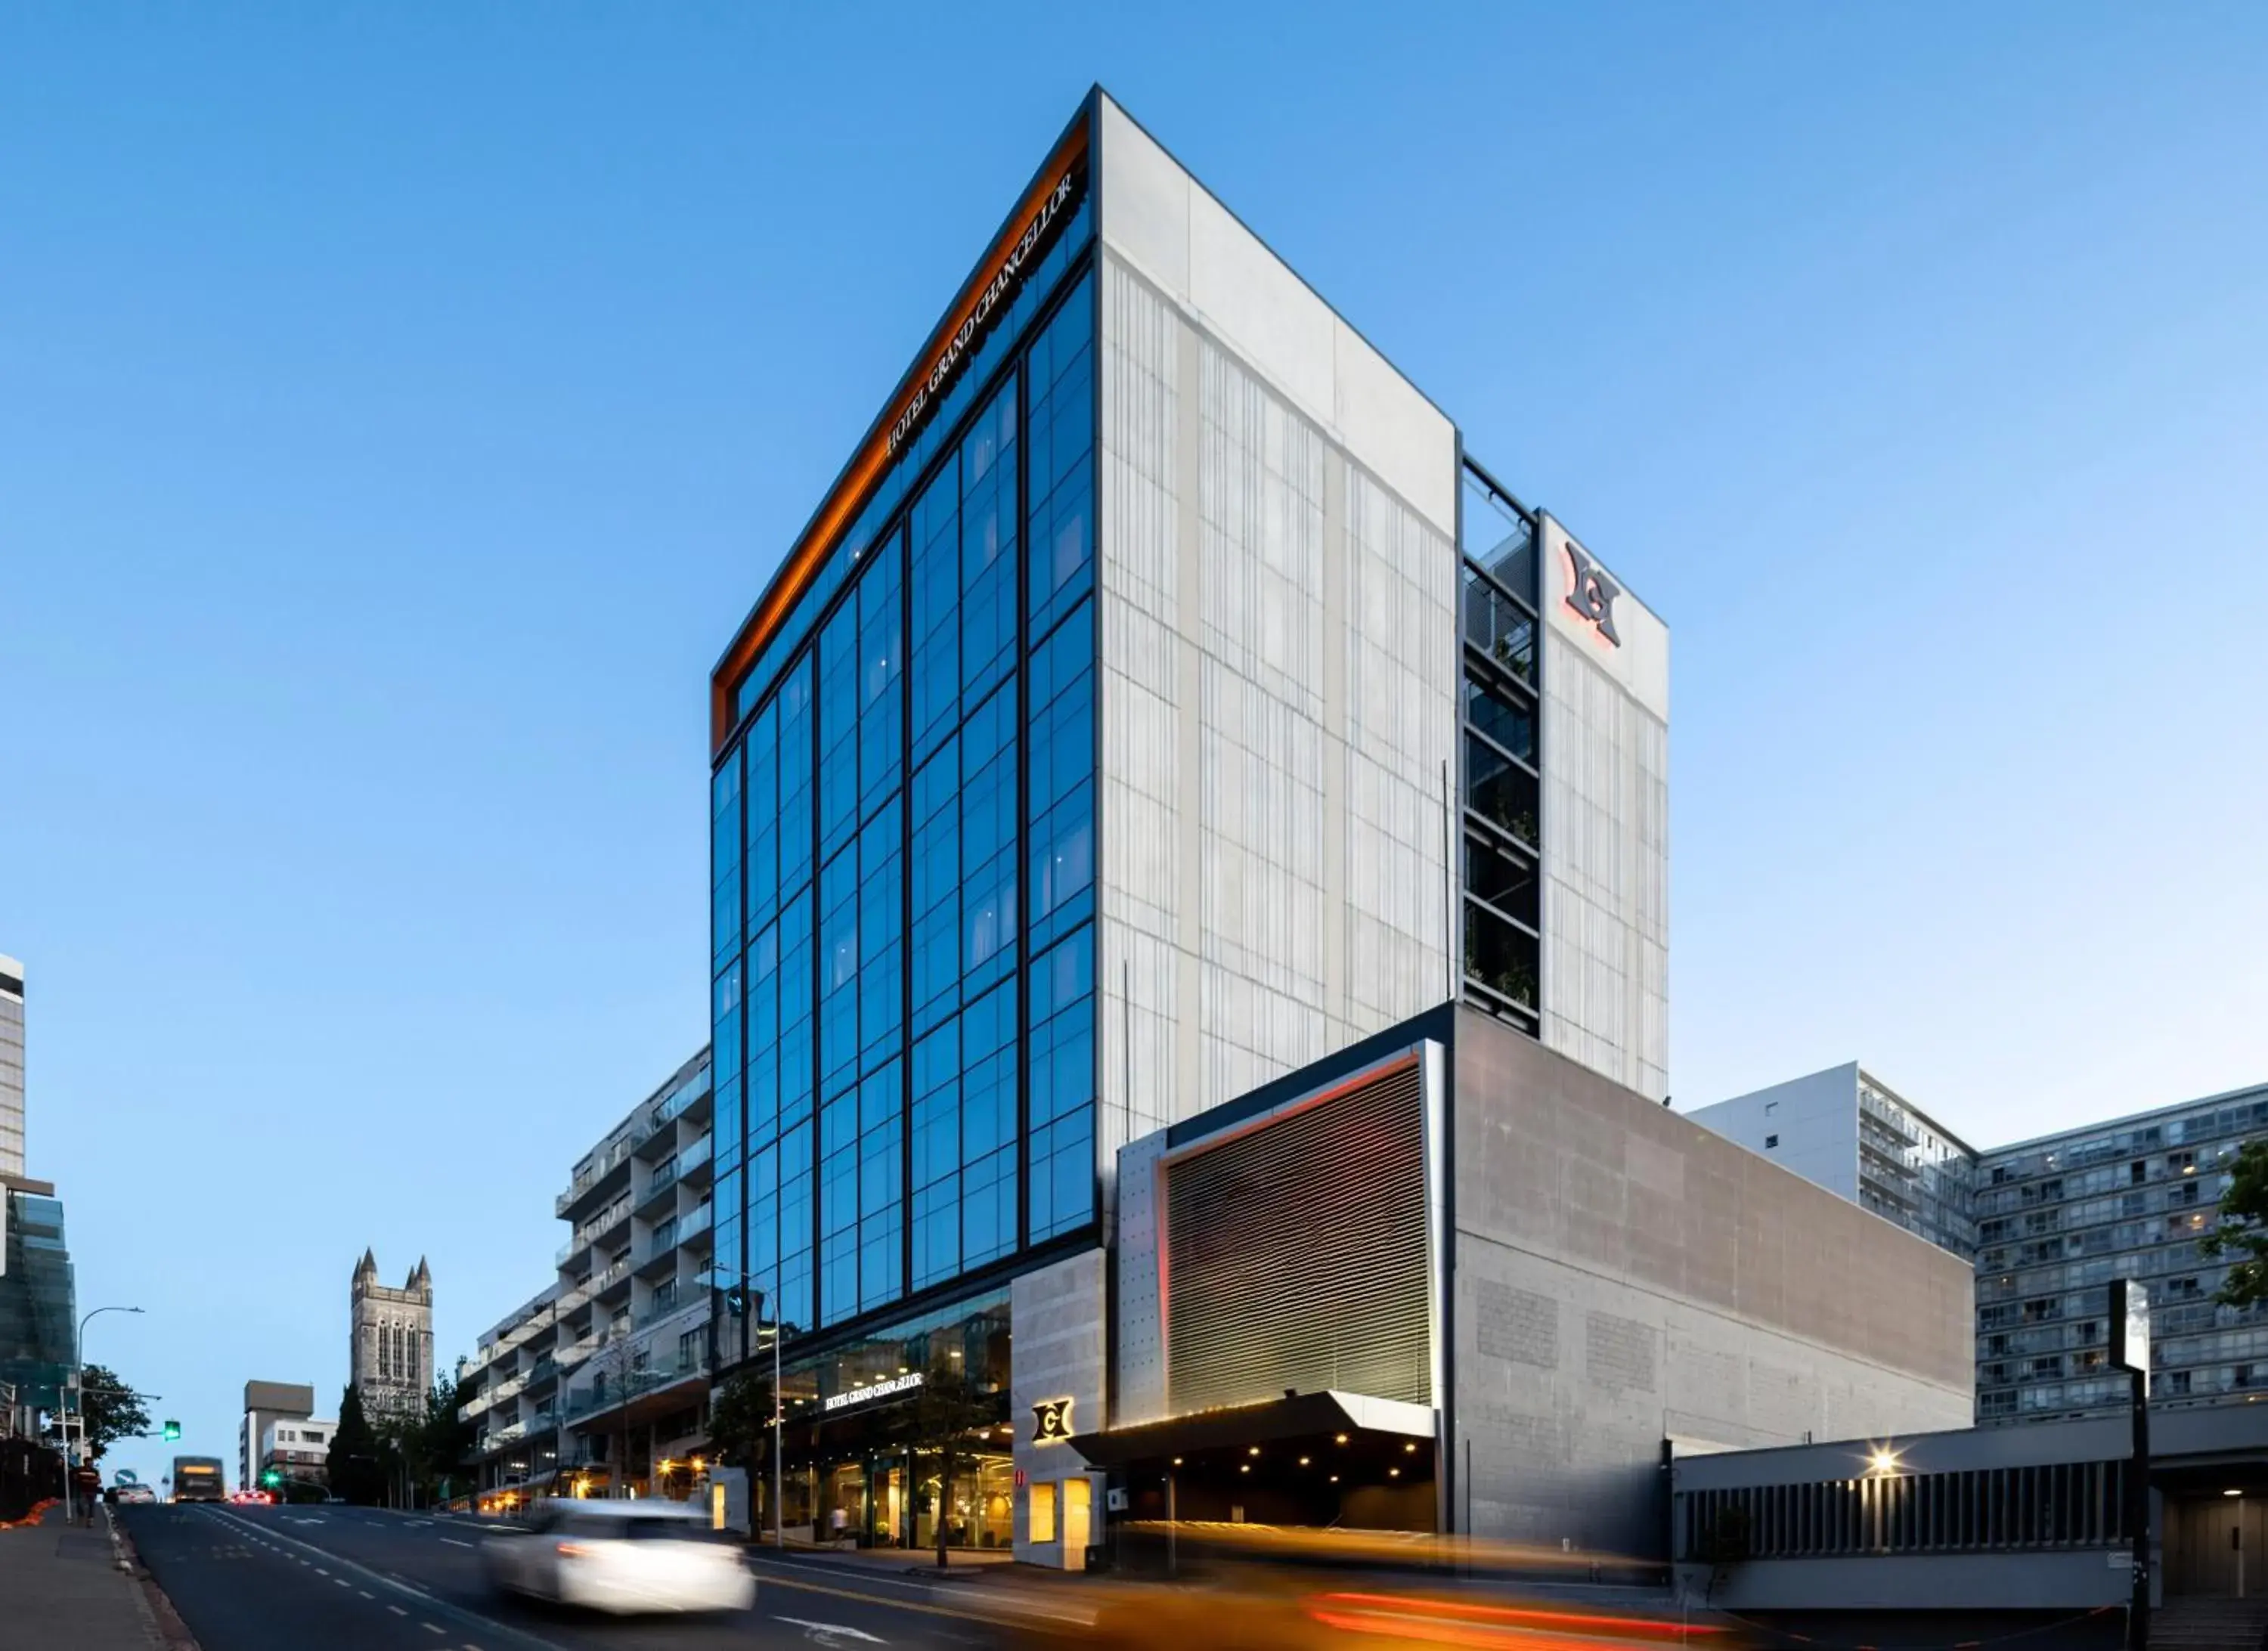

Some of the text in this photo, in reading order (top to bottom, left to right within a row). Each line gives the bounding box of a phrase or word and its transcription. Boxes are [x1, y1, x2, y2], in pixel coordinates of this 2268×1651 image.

[888, 172, 1073, 456] HOTEL GRAND CHANCELLOR
[826, 1393, 849, 1411] HOTEL
[849, 1386, 873, 1403] GRAND
